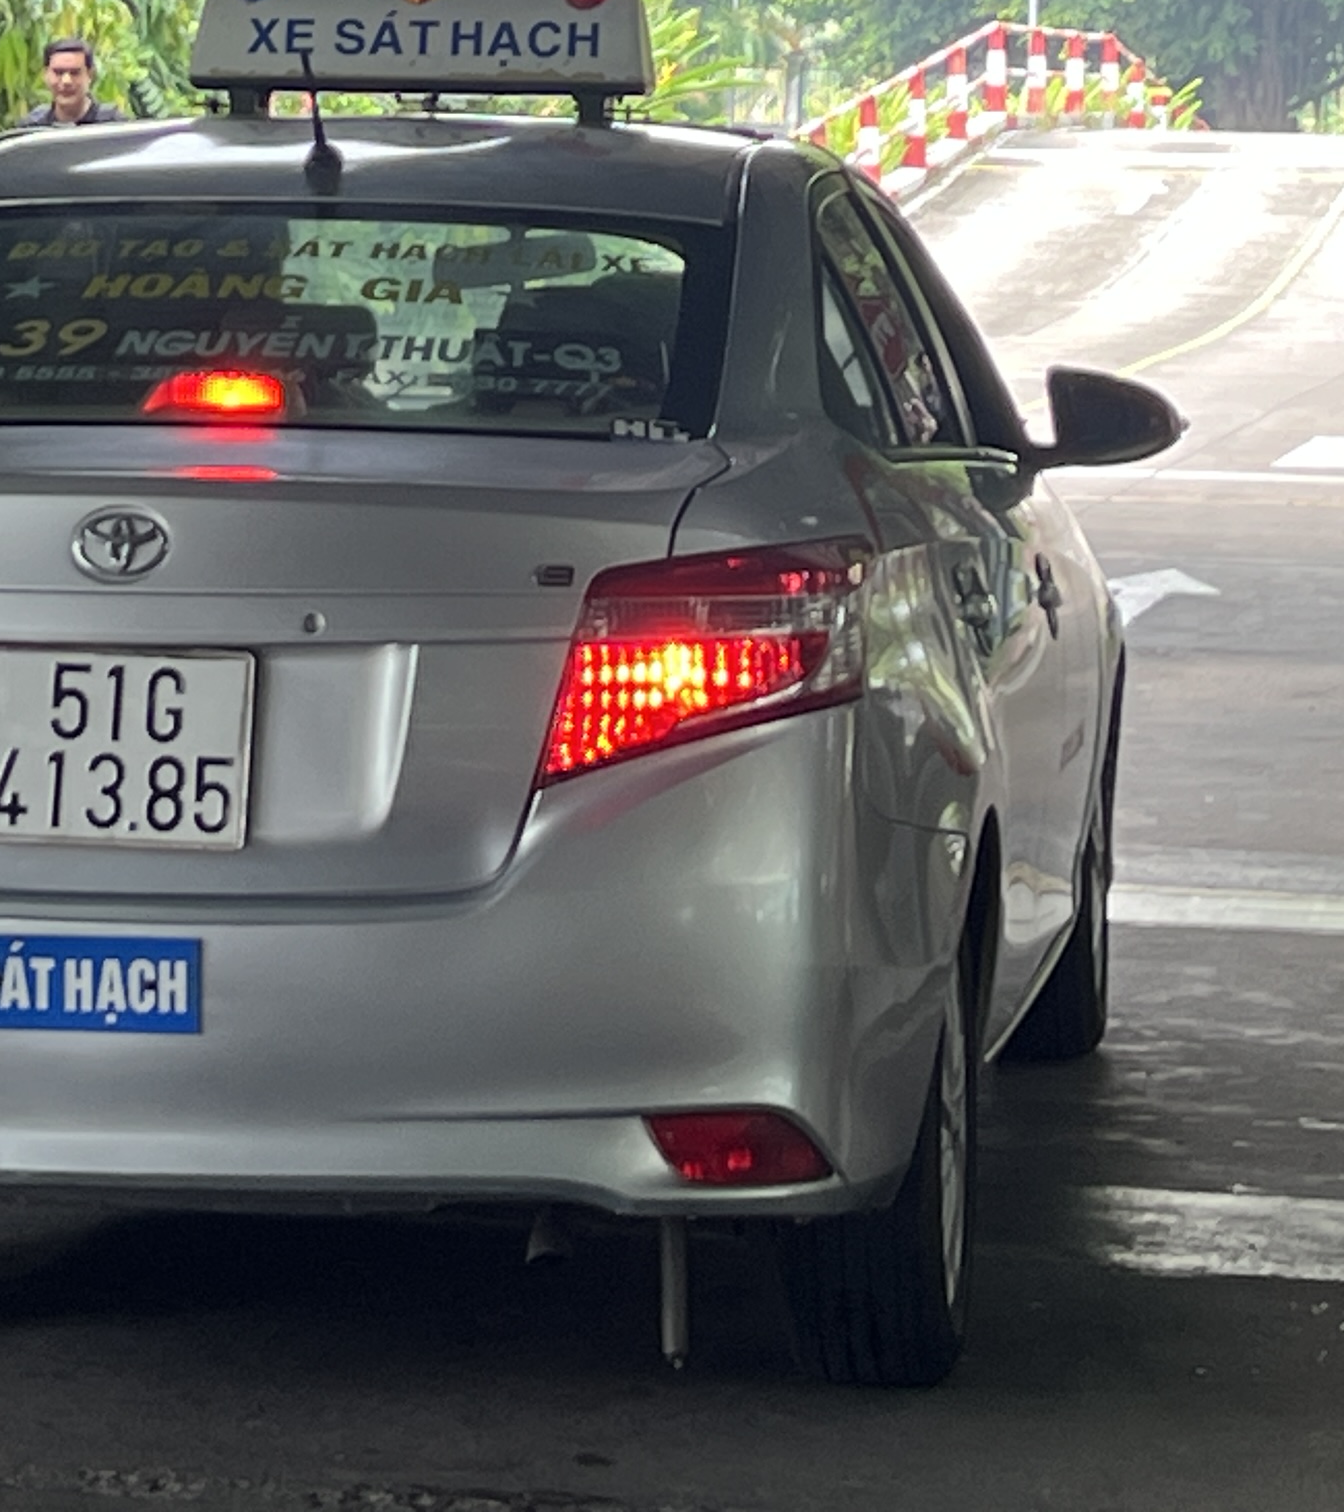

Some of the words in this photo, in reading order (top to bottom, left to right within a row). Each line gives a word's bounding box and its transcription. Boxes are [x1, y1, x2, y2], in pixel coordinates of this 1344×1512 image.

[246, 17, 315, 55] XE
[334, 9, 440, 56] SÁT
[449, 19, 600, 67] HẠCH
[81, 267, 310, 300] HOÀNG
[359, 277, 464, 305] GIA
[49, 661, 186, 744] 51G
[62, 955, 188, 1026] HẠCH
